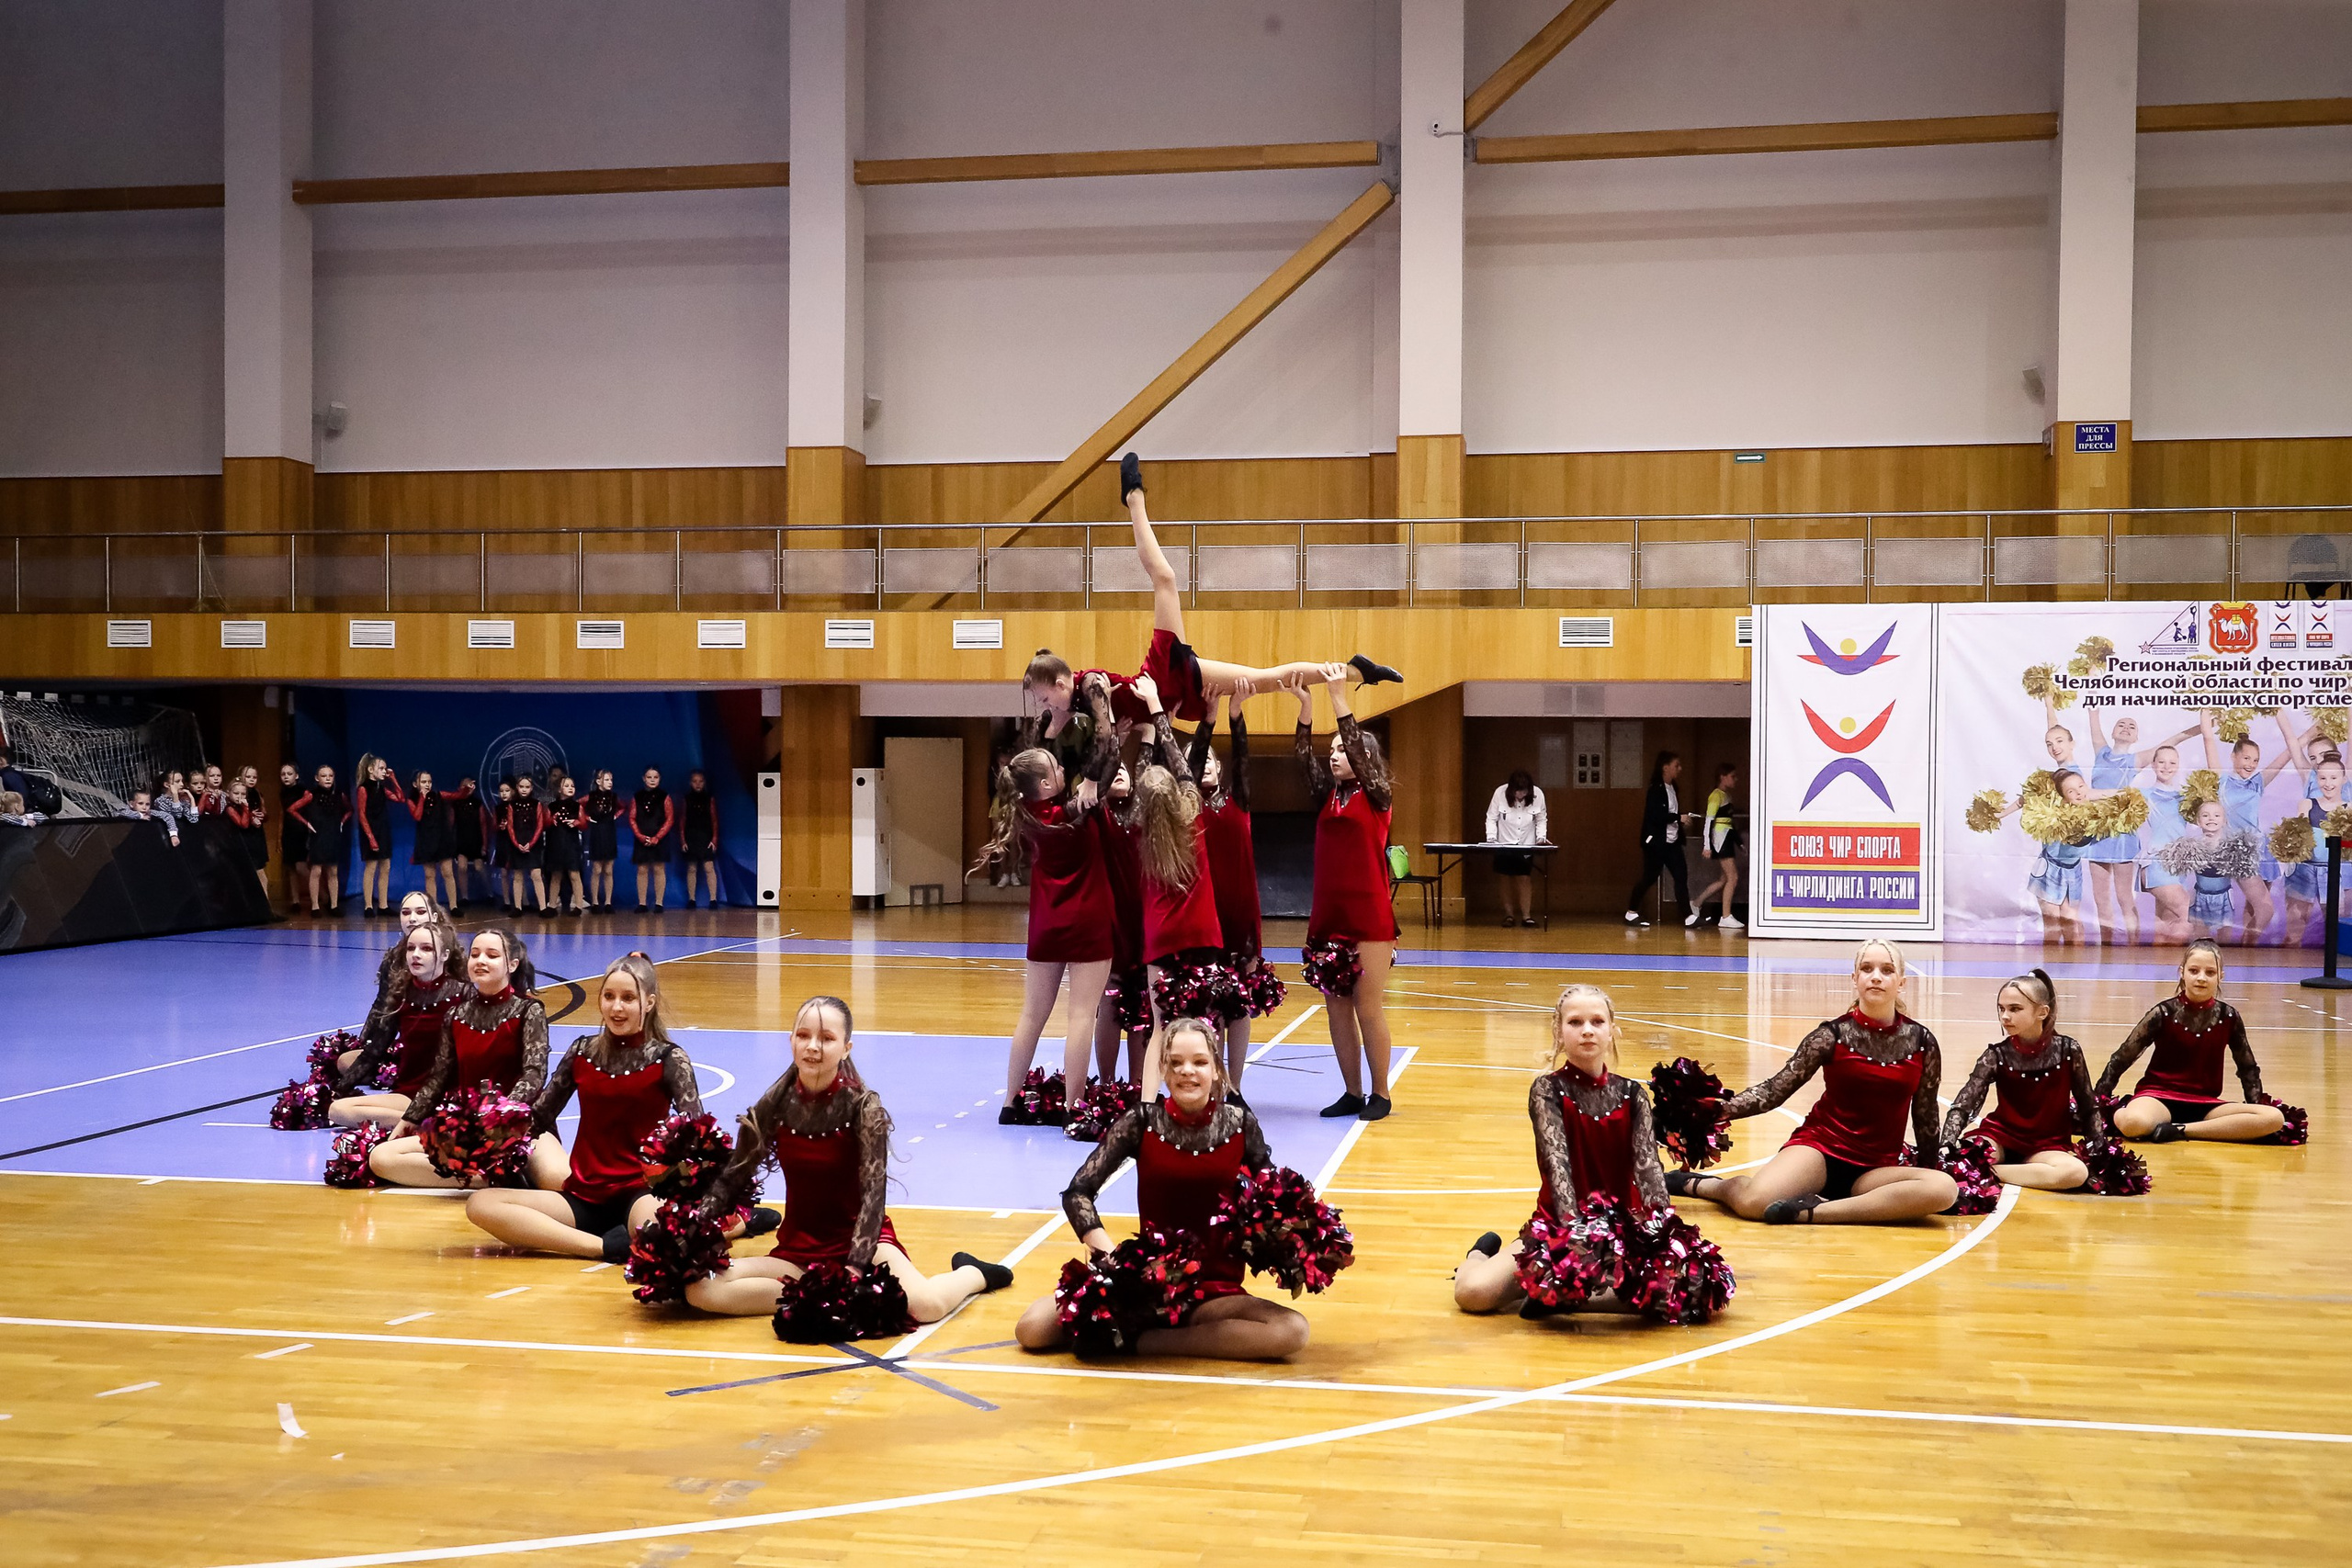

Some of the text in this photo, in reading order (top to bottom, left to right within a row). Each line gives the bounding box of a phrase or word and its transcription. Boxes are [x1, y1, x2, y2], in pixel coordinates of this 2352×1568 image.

[2109, 656, 2352, 674] Региональный фестивал
[2054, 674, 2347, 692] Челябинской области по чир
[2083, 694, 2352, 709] для начинающих спортсме
[1790, 835, 1901, 859] СОЮЗ ЧИР СПОРТА
[1776, 875, 1916, 902] И ЧИРЛИДИНГА РОССИИ
